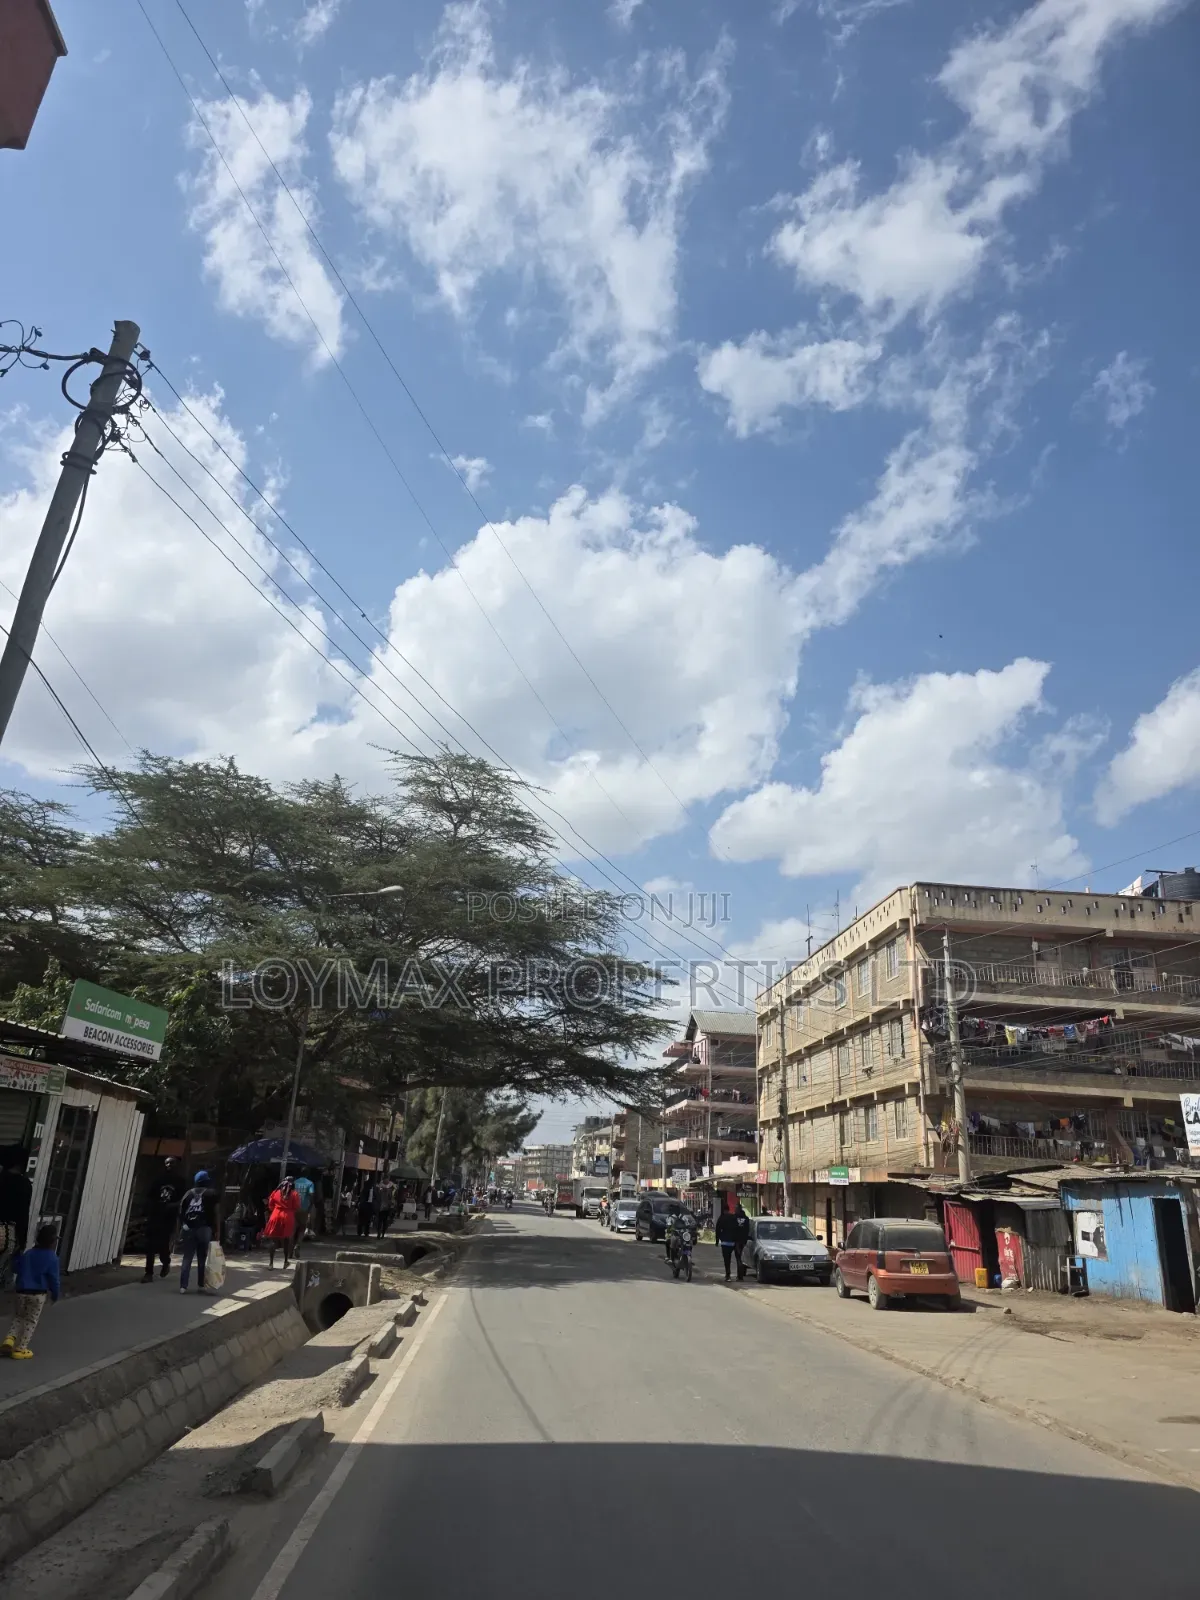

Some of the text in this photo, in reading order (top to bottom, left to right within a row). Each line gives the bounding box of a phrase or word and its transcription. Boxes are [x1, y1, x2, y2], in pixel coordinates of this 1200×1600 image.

[84, 998, 122, 1021] Safaricom
[83, 1026, 155, 1056] BEACON ACCESSORIES
